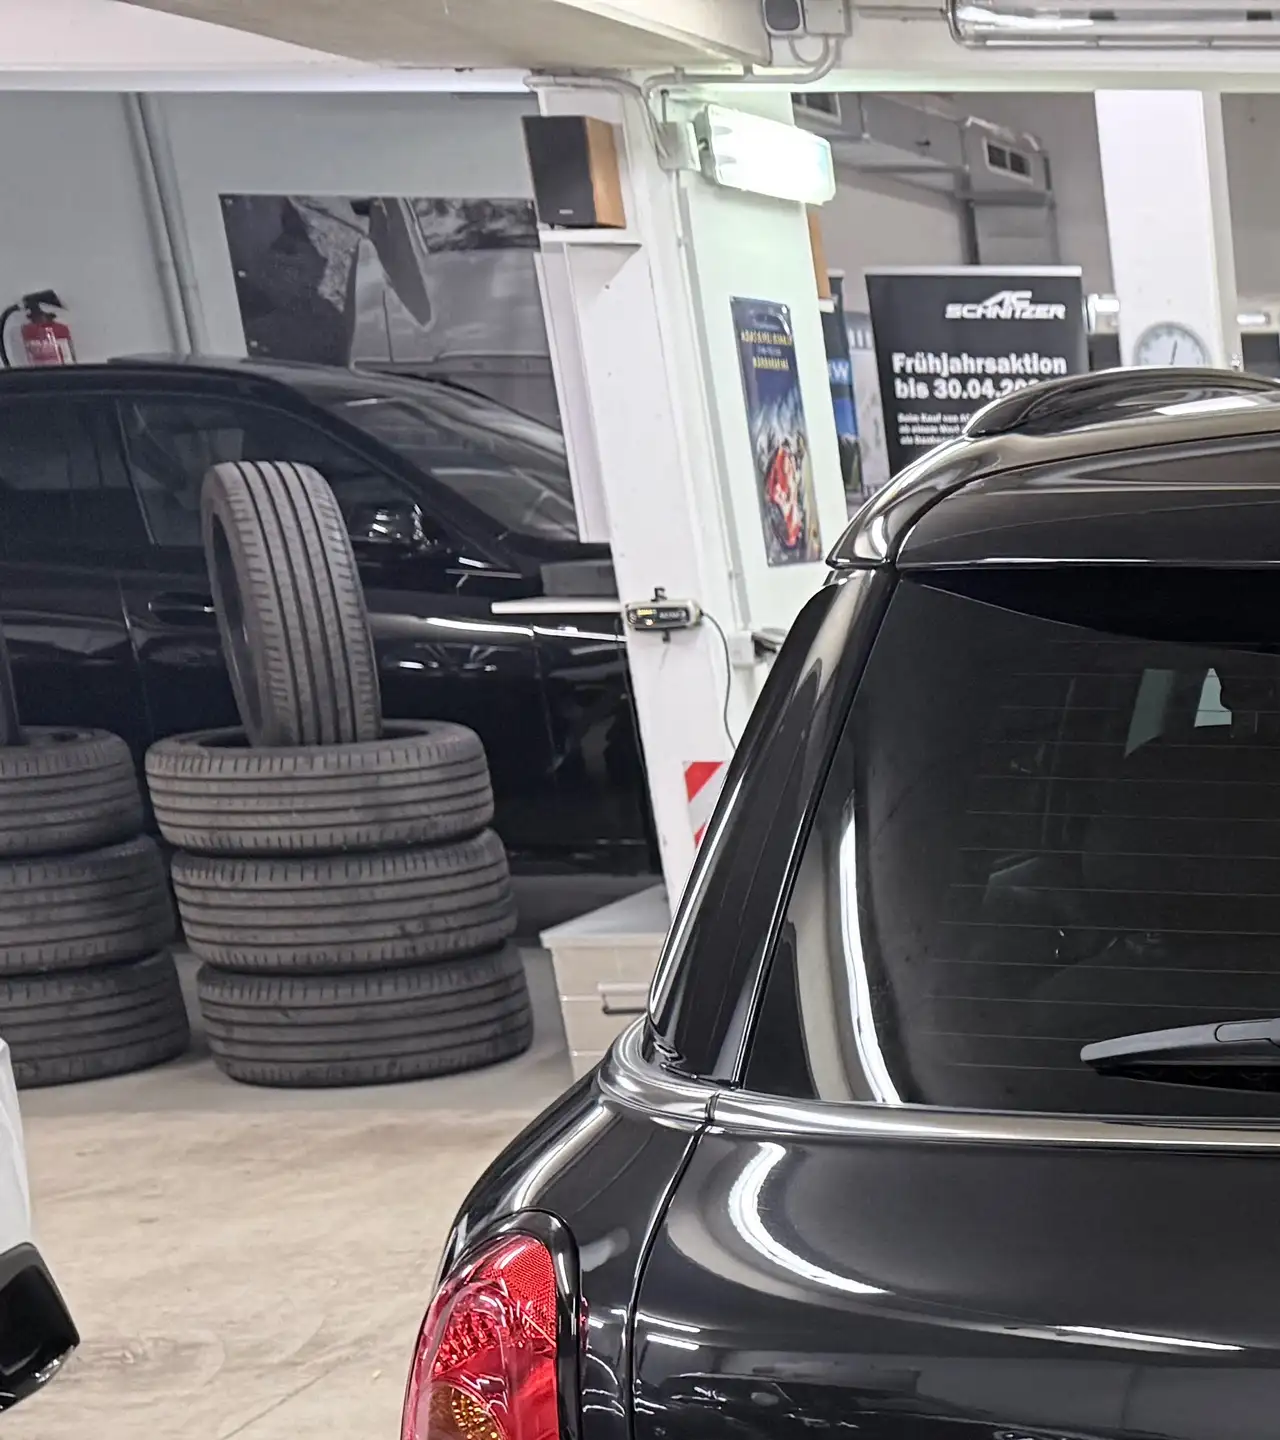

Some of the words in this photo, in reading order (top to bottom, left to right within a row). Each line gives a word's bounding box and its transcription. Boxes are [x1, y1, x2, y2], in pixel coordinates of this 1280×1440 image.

[945, 302, 1066, 319] SCHNITZER
[892, 352, 1067, 377] Frühjahrsaktion
[895, 378, 929, 399] bis
